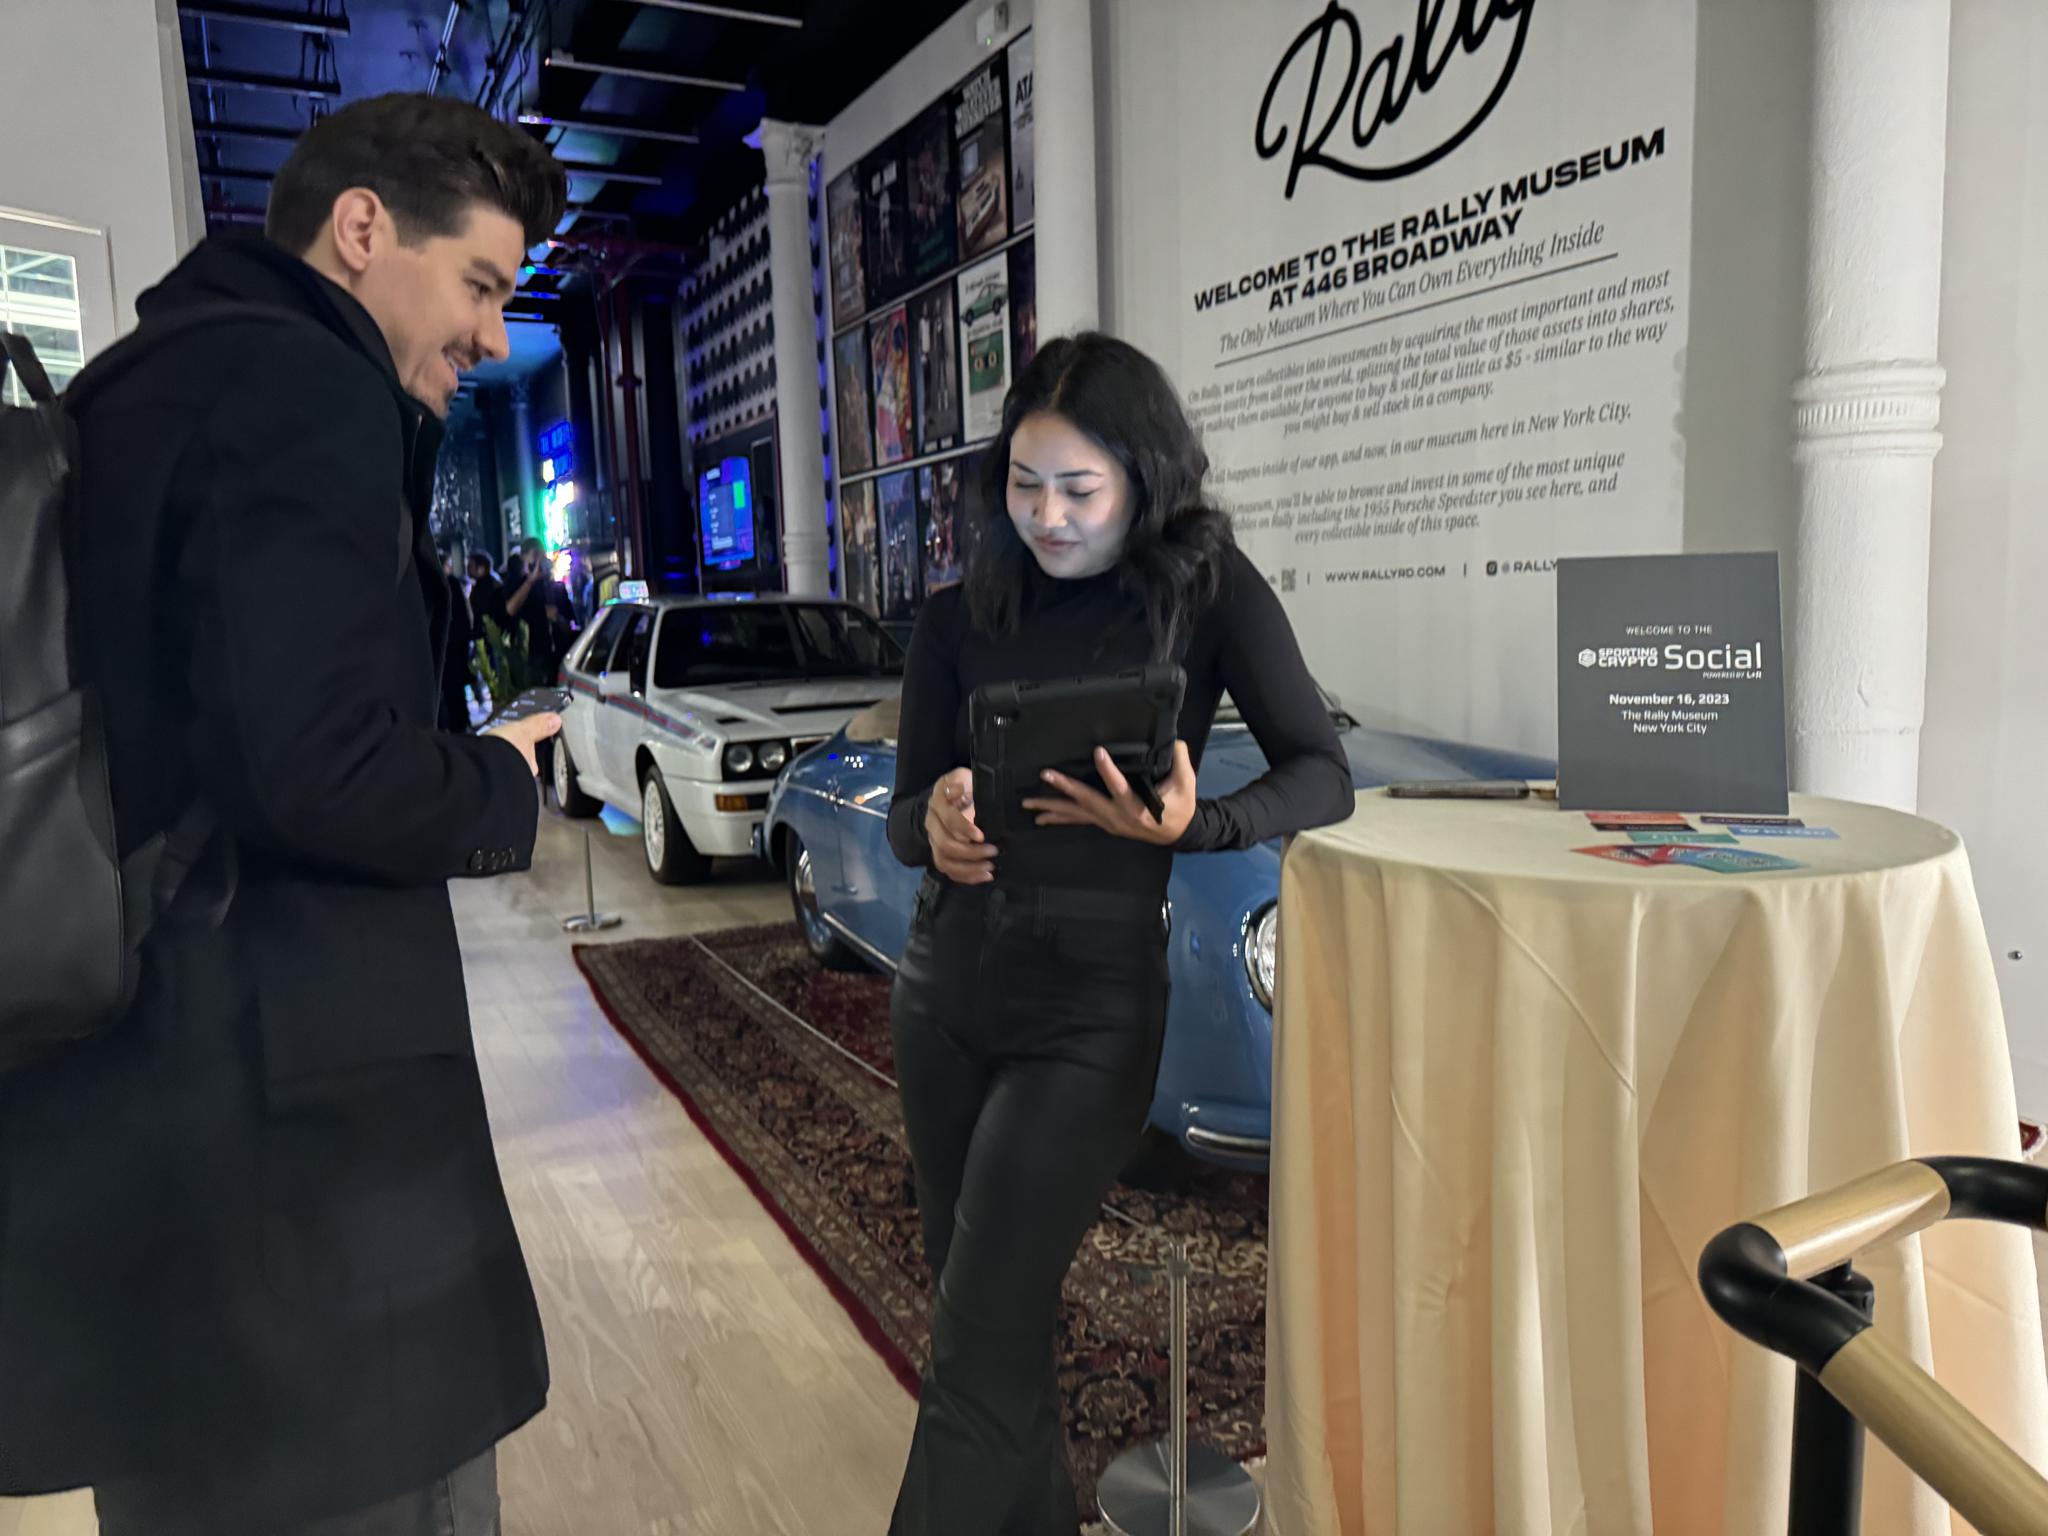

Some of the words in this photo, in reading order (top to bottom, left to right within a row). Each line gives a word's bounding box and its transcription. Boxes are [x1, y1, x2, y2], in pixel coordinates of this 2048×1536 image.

[1194, 257, 1300, 312] WELCOME
[1304, 245, 1337, 273] TO
[1342, 222, 1395, 261] THE
[1401, 185, 1495, 241] RALLY
[1501, 127, 1665, 209] MUSEUM
[1269, 283, 1298, 312] AT
[1302, 268, 1348, 299] 446
[1353, 207, 1524, 285] BROADWAY
[1220, 333, 1240, 354] The
[1240, 325, 1265, 350] Only
[1267, 311, 1315, 338] Museum
[1318, 297, 1359, 324] Where
[1361, 288, 1386, 311] You
[1388, 280, 1416, 302] Can
[1418, 267, 1452, 294] Own
[1455, 238, 1548, 284] Everything
[1549, 219, 1606, 258] Inside
[1306, 357, 1326, 374] into
[1327, 341, 1388, 370] investments
[1390, 335, 1403, 356] by
[1405, 322, 1462, 349] acquiring
[1464, 314, 1486, 334] the
[1487, 306, 1518, 329] most
[1521, 288, 1594, 322] important
[1597, 276, 1628, 302] and
[1631, 269, 1670, 294] most
[1356, 360, 1400, 384] splitting
[1402, 353, 1421, 371] the
[1423, 346, 1450, 366] total
[1454, 337, 1487, 359] value
[1489, 330, 1505, 351] of
[1505, 325, 1540, 348] those
[1542, 315, 1584, 338] assets
[1587, 307, 1617, 330] into
[1620, 295, 1675, 321] shares,
[1355, 386, 1366, 402] to
[1367, 381, 1388, 400] buy
[1400, 370, 1420, 391] sell
[1419, 369, 1439, 391] for
[1440, 366, 1454, 383] as
[1456, 357, 1487, 379] little
[1488, 358, 1503, 374] as
[1504, 347, 1523, 371] $5
[1533, 337, 1588, 364] similar
[1589, 333, 1604, 351] to
[1607, 326, 1632, 349] the
[1634, 320, 1668, 344] way
[1302, 413, 1330, 433] might
[1332, 406, 1351, 427] buy
[1362, 398, 1381, 418] sell
[1382, 394, 1409, 416] stock
[1412, 391, 1424, 409] in
[1426, 392, 1434, 408] a
[1436, 380, 1494, 406] company.
[1342, 443, 1363, 463] and
[1390, 438, 1402, 457] in
[1403, 437, 1424, 453] our
[1426, 428, 1477, 449] museum
[1480, 421, 1510, 441] here
[1512, 417, 1525, 436] in
[1527, 414, 1559, 434] New
[1561, 404, 1597, 428] York
[1337, 486, 1348, 503] to
[1349, 483, 1386, 501] browse
[1387, 476, 1410, 496] and
[1411, 472, 1444, 494] invest
[1447, 470, 1459, 489] in
[1461, 469, 1494, 487] some
[1496, 462, 1512, 485] of
[1512, 459, 1534, 479] the
[1536, 456, 1570, 477] most
[1573, 450, 1626, 474] unique
[1344, 504, 1360, 521] the
[1391, 494, 1436, 516] Porsche
[1437, 487, 1499, 513] Speedster
[1498, 486, 1523, 508] you
[1526, 484, 1547, 501] see
[1549, 479, 1584, 500] here,
[1588, 472, 1618, 493] and
[1321, 520, 1372, 543] collectible
[1373, 516, 1406, 537] inside
[1406, 514, 1421, 537] of
[1420, 512, 1443, 533] this
[1445, 512, 1480, 533] space.
[1598, 646, 1658, 657] SPORTING
[1664, 641, 1763, 670] Social
[1626, 625, 1674, 636] WELCOME
[1677, 624, 1691, 635] TO
[1695, 624, 1713, 635] THE
[1598, 656, 1659, 668] CRYPTO
[1609, 693, 1675, 706] November
[1677, 693, 1696, 707] 16,
[1698, 693, 1731, 706] 2023
[1621, 709, 1642, 721] The
[1644, 709, 1669, 723] Rally
[1671, 709, 1719, 722] Museum
[1633, 722, 1658, 734] New
[1660, 722, 1685, 734] York
[1686, 722, 1707, 736] City
